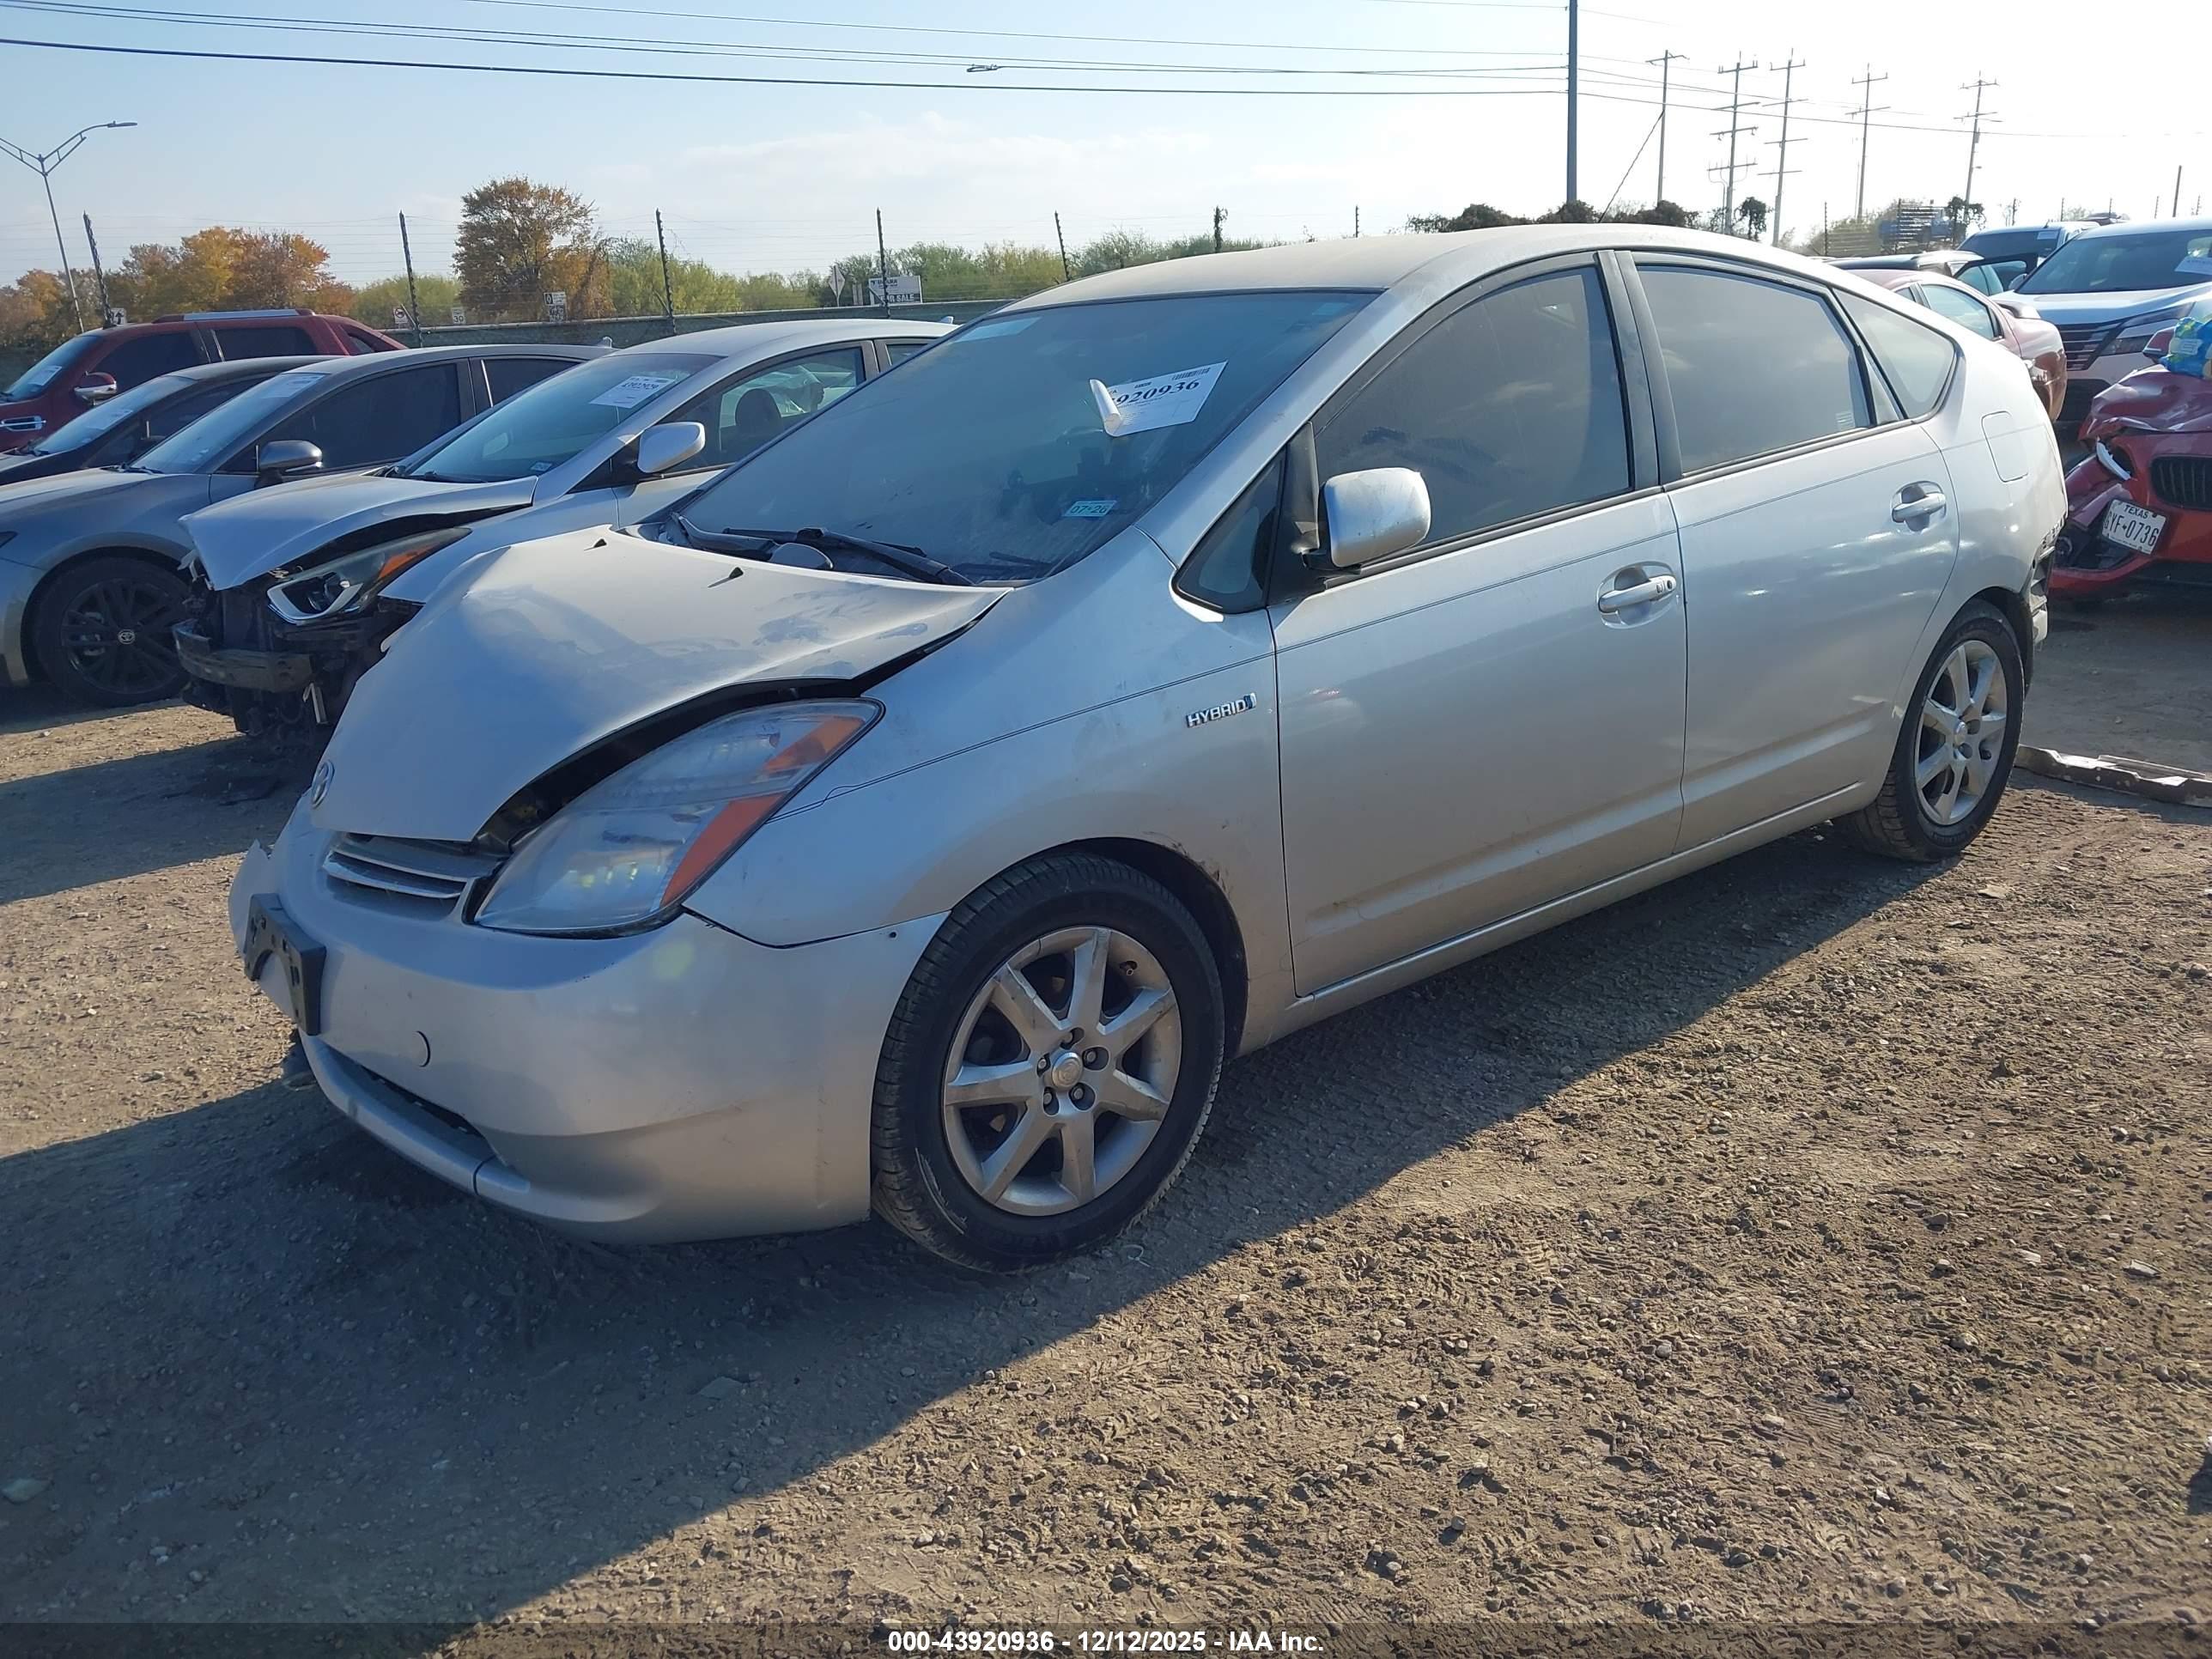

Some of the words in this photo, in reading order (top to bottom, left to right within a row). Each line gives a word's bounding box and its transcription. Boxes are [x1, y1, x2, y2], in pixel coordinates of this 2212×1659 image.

[896, 294, 915, 302] SALE
[1112, 379, 1201, 406] 920936
[2124, 505, 2149, 520] TEXAS
[1187, 699, 1247, 728] HYBRID
